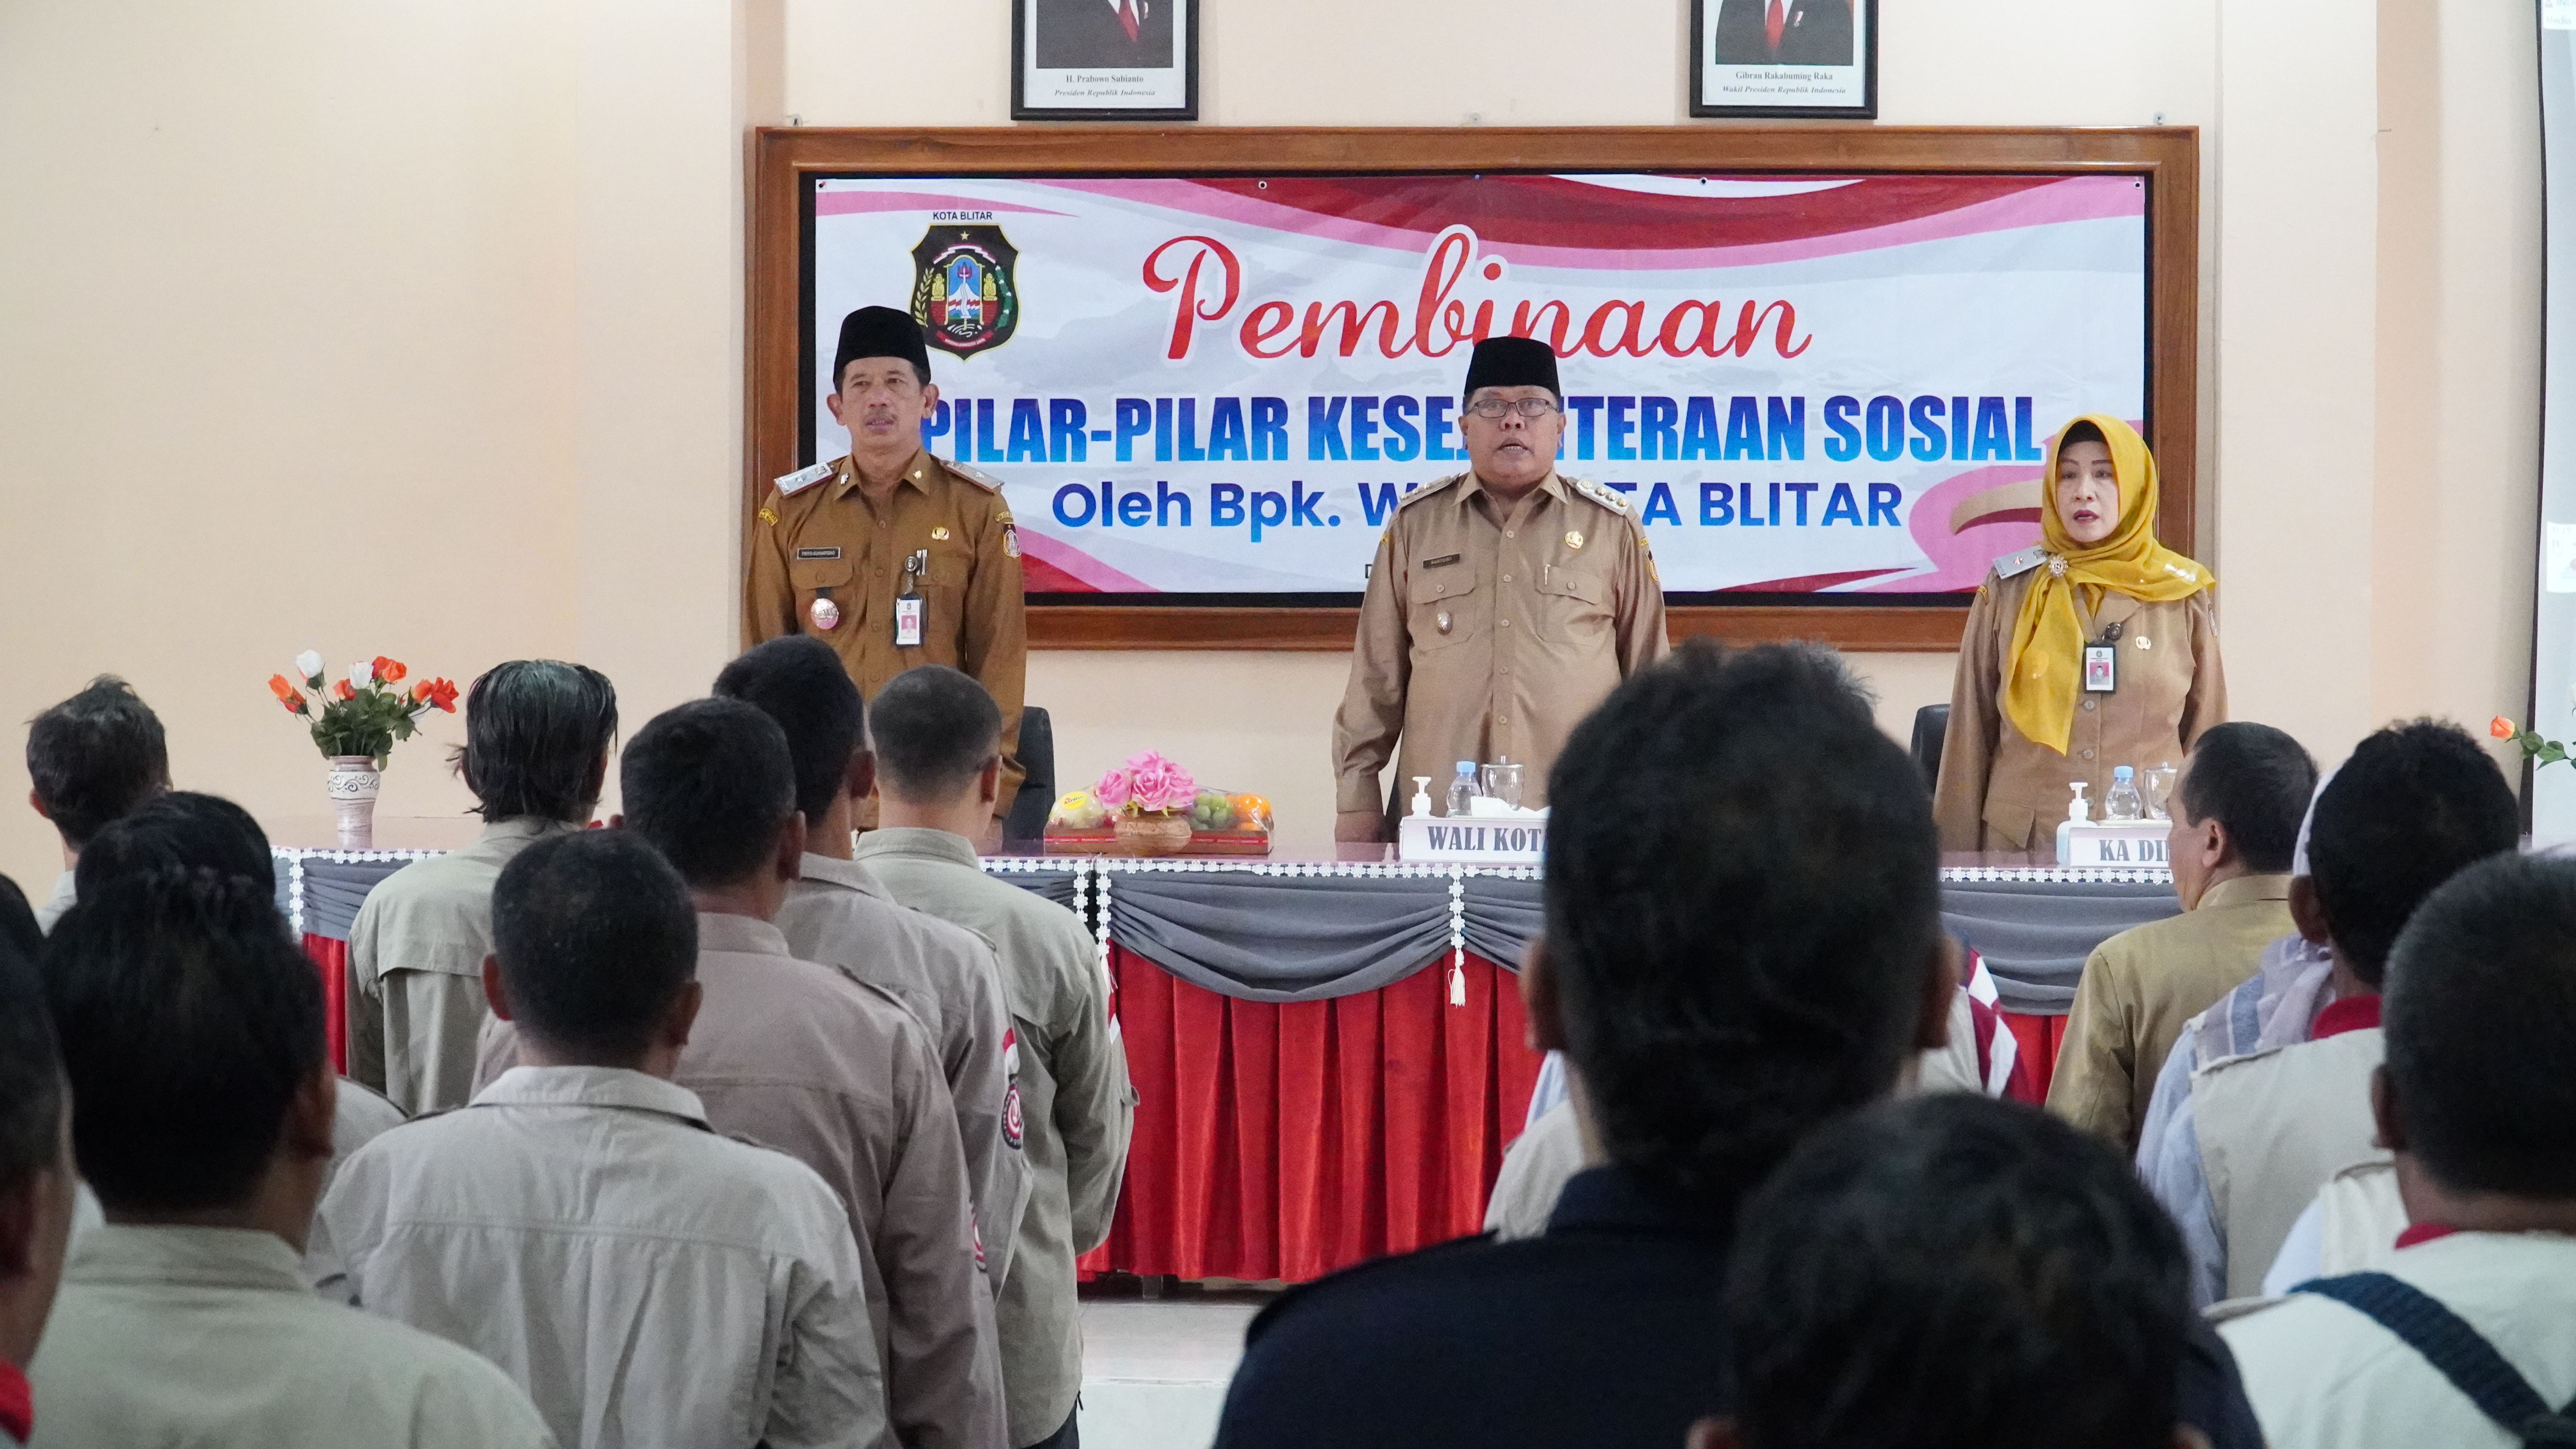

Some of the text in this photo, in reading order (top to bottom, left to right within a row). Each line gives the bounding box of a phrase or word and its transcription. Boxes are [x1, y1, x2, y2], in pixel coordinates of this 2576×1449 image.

[1077, 75, 1109, 83] Prabowo
[1736, 71, 1833, 81] Gibran Rakabuming Raka
[1087, 89, 1118, 97] Republik
[933, 212, 993, 220] KOTA BLITAR
[1142, 232, 1812, 359] Pembinaan
[920, 394, 2041, 462] PILAR-PILAR KESETERAAN SOSIAL
[1052, 481, 1191, 527] Oleh
[1211, 480, 1340, 543] Bpk.
[1700, 482, 1902, 526] BLITAR
[1428, 826, 1546, 851] WALI KOT
[2099, 840, 2130, 861] KA
